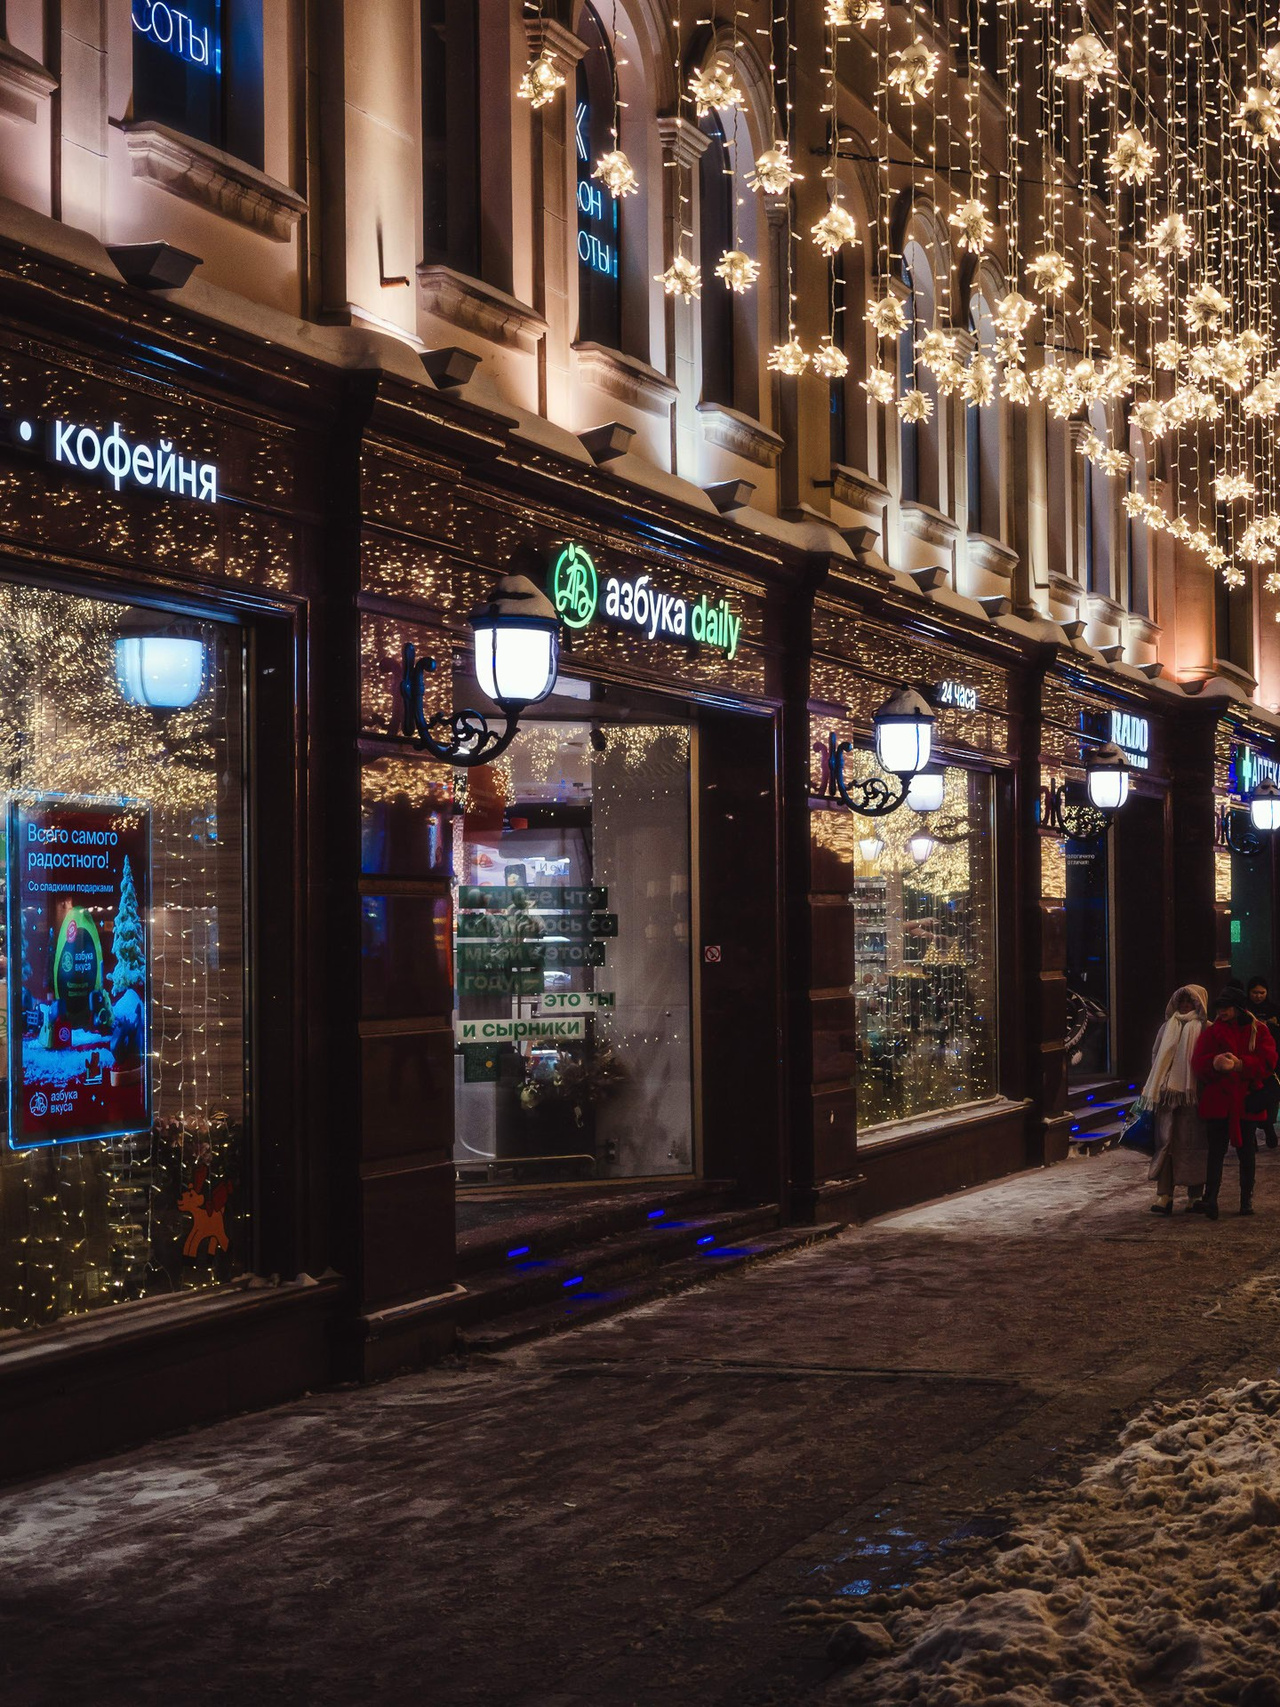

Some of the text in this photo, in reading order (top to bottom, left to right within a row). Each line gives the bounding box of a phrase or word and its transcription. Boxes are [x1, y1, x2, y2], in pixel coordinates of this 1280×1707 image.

[55, 420, 217, 503] кофейня
[605, 575, 741, 661] азбука daily
[941, 681, 976, 710] 24 часа
[1111, 710, 1148, 752] RADO
[28, 823, 118, 846] Всего самого
[28, 850, 109, 871] радостного!
[28, 880, 114, 894] Со сладкими подарками
[563, 890, 600, 904] что
[587, 918, 613, 932] со
[545, 946, 598, 960] этом
[544, 993, 614, 1007] это ты
[463, 1020, 580, 1040] и сырники
[51, 1089, 78, 1103] азбука
[51, 1102, 73, 1115] вкуса
